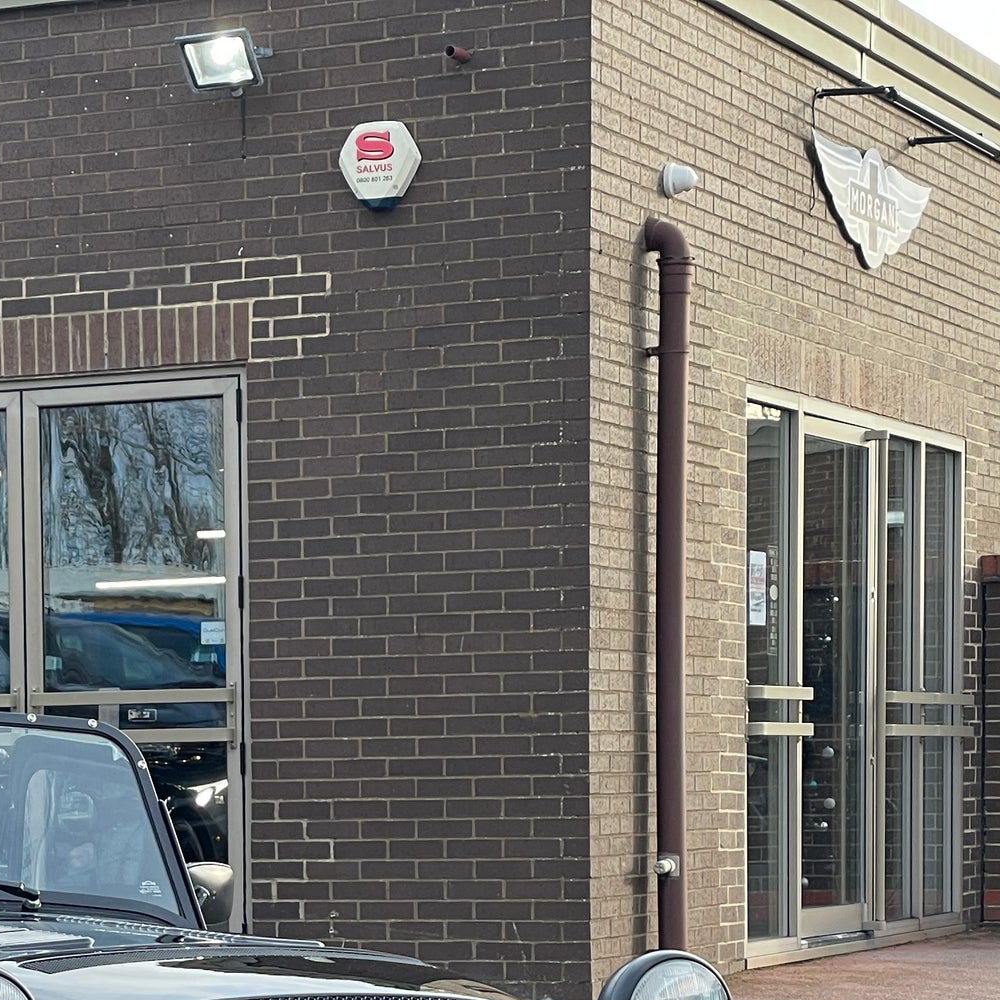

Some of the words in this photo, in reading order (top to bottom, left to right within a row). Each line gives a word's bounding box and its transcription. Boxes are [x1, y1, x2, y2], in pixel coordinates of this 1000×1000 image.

[355, 130, 395, 162] S
[356, 163, 393, 174] SALVUS
[851, 187, 895, 228] MORGAN
